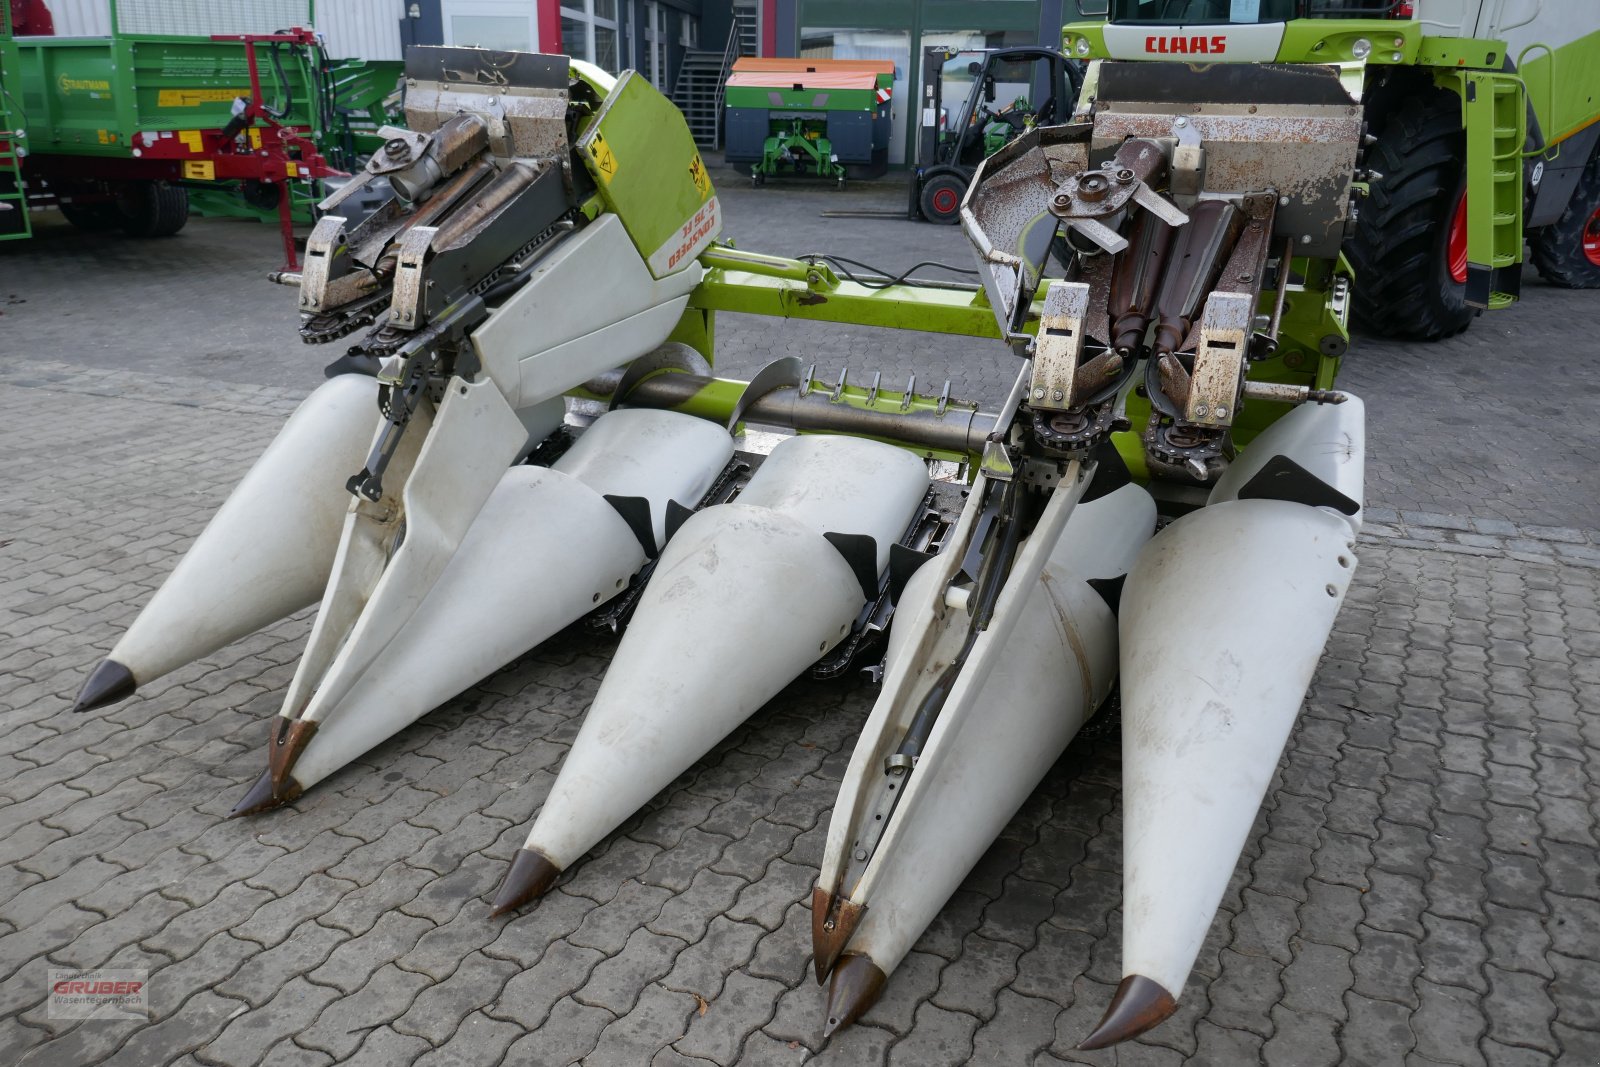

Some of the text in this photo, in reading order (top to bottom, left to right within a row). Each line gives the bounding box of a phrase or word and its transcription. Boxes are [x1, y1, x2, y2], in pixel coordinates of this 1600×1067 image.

[1145, 36, 1226, 54] CLAAS
[682, 199, 714, 239] 6-75 FC
[668, 215, 714, 269] CONSPEED
